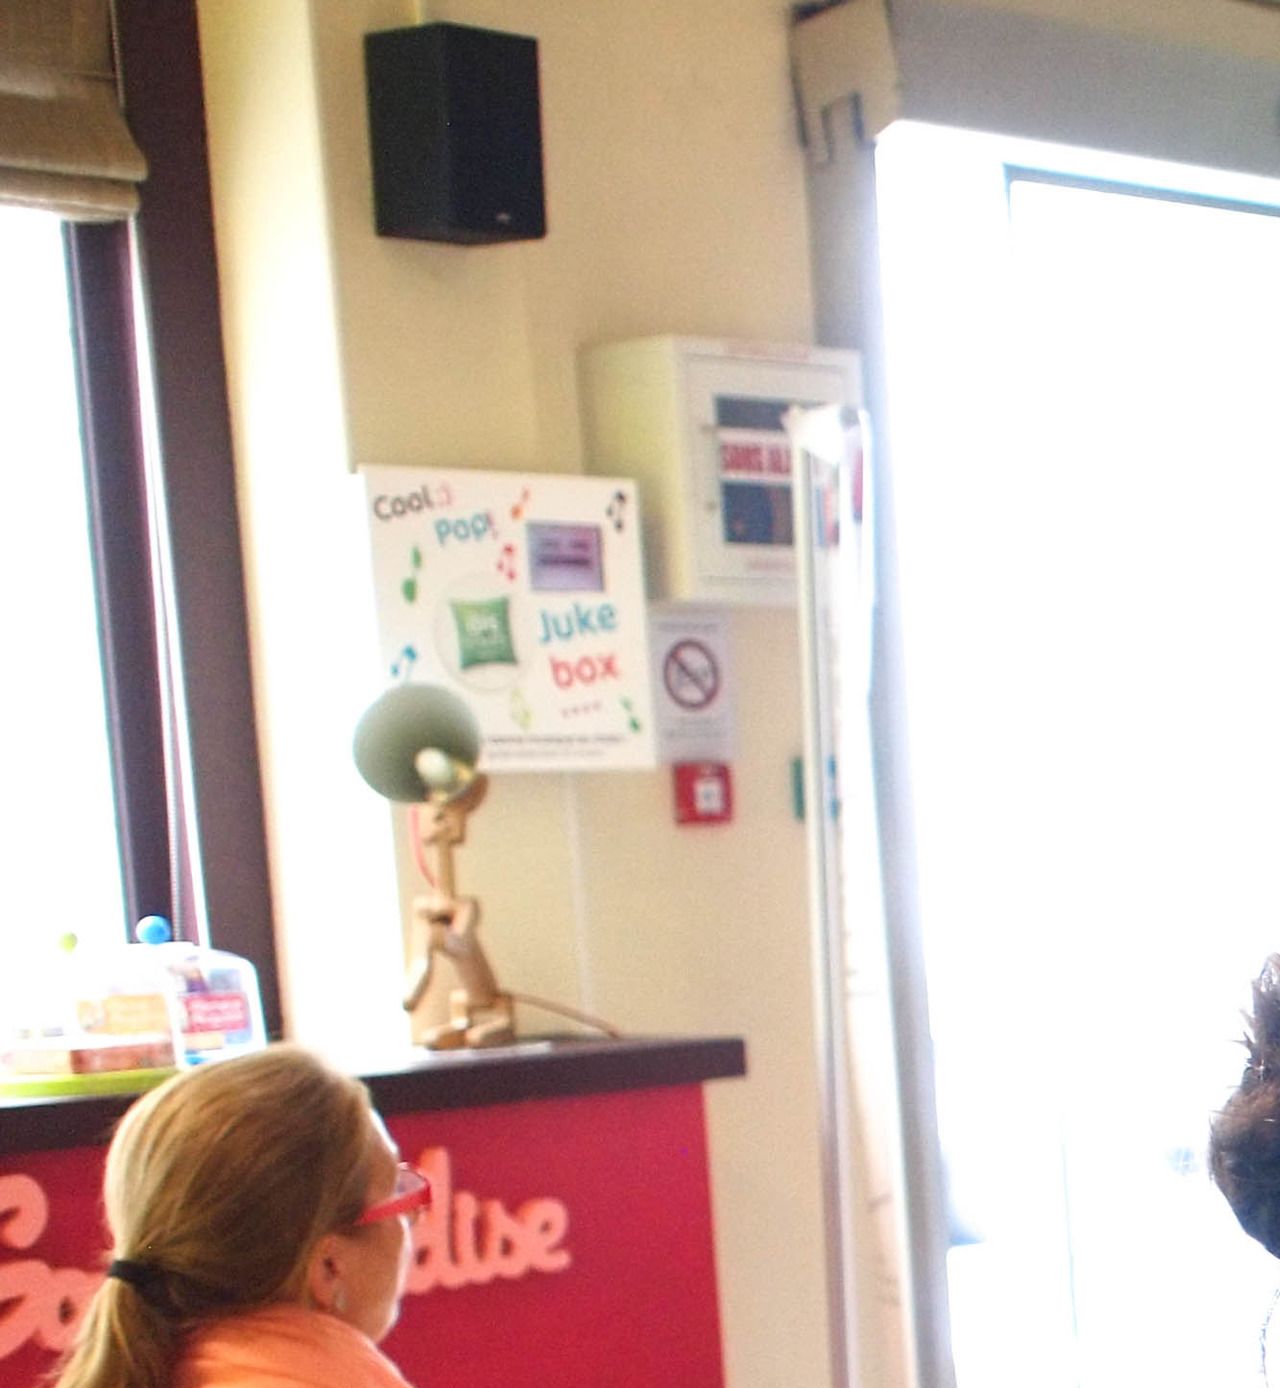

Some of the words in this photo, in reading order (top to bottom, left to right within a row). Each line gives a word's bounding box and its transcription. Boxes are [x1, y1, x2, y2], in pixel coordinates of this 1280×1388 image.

[373, 484, 434, 521] Cool
[537, 602, 618, 644] Juke
[549, 652, 620, 689] box
